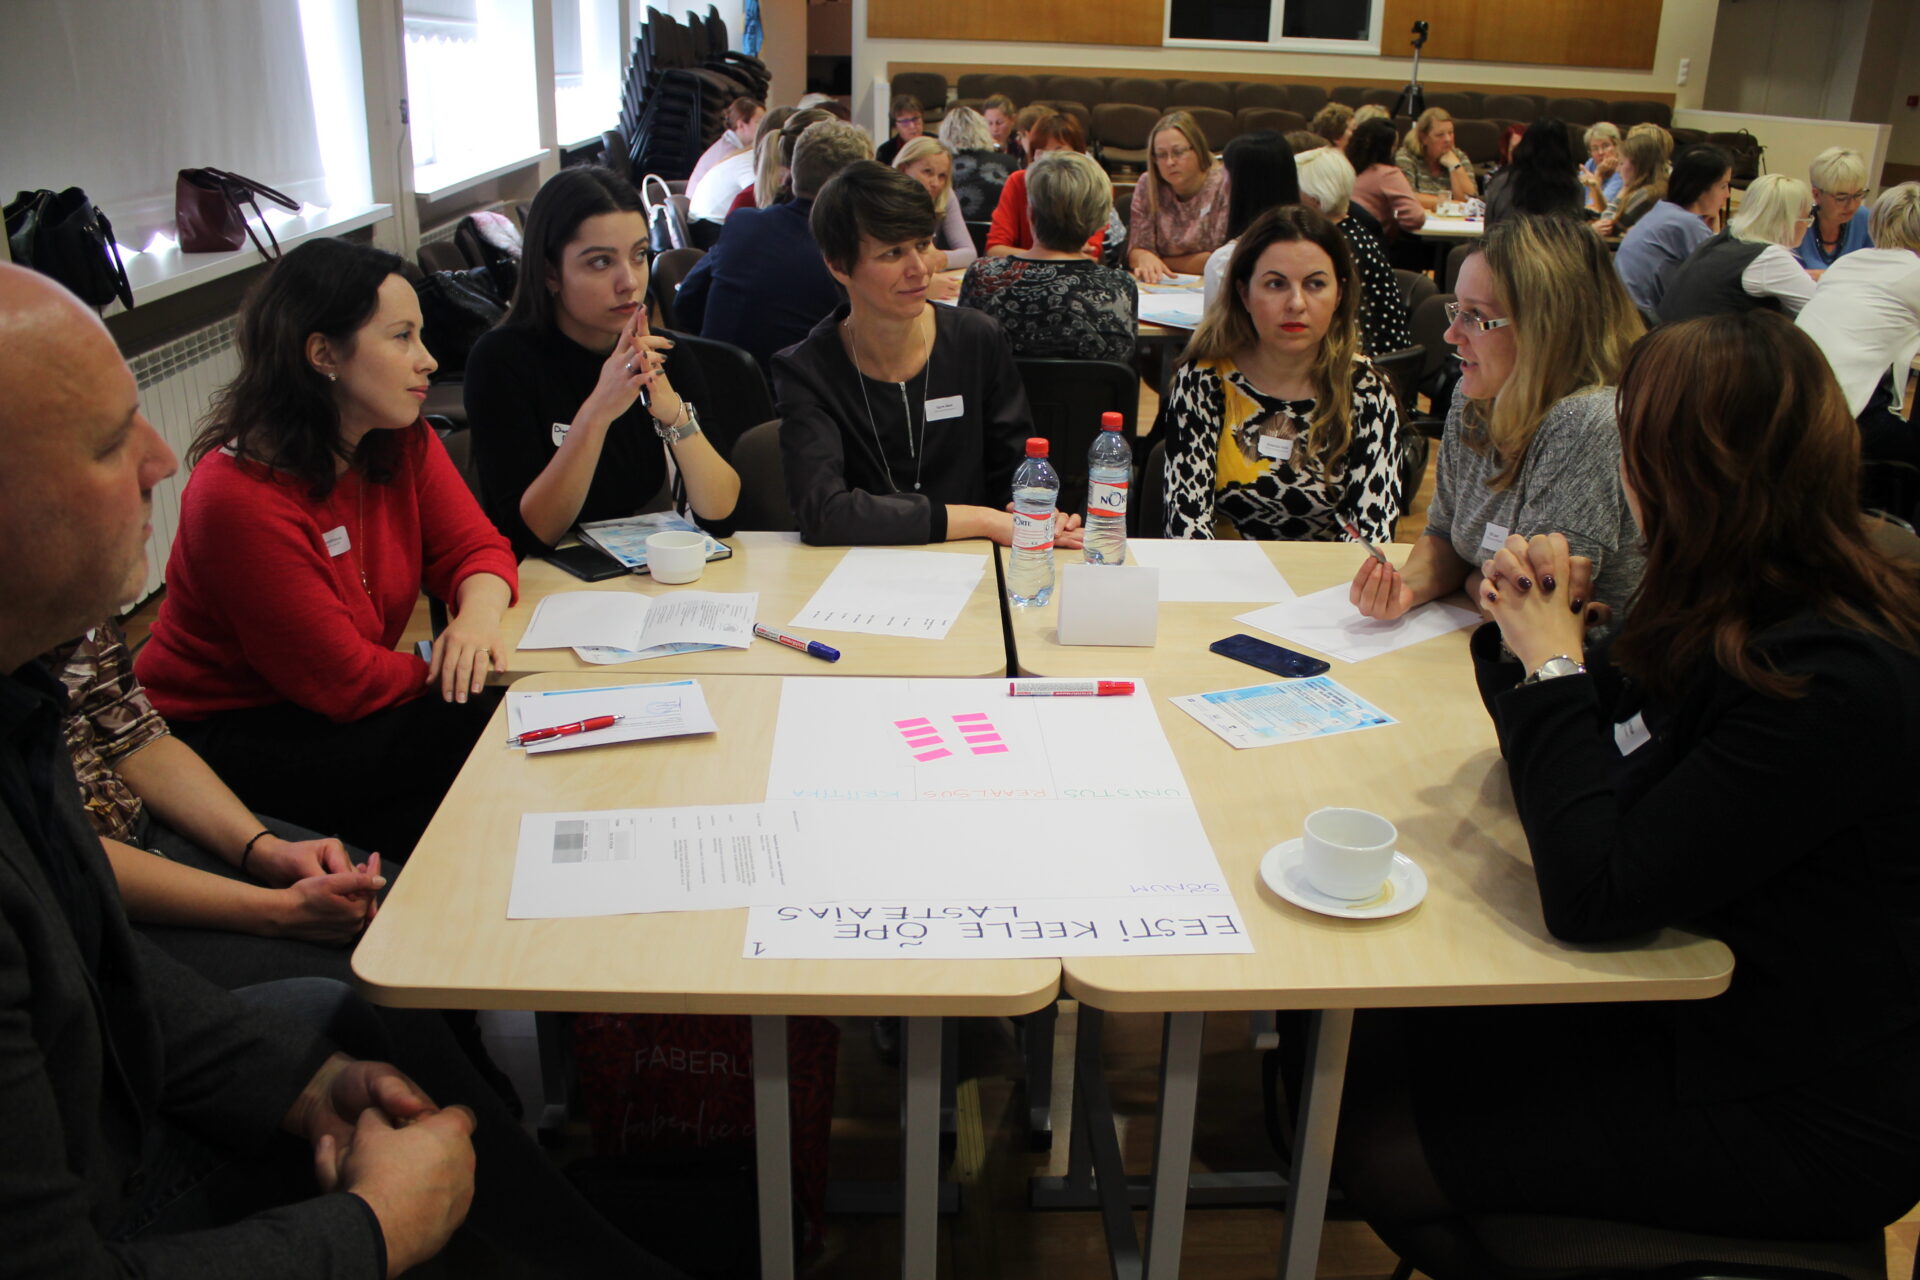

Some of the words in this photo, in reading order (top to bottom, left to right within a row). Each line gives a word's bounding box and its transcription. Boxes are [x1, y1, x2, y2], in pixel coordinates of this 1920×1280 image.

[922, 787, 1047, 799] REAALSUS
[833, 921, 928, 948] ÕPE
[958, 920, 1098, 939] KEELE
[752, 941, 767, 956] 1
